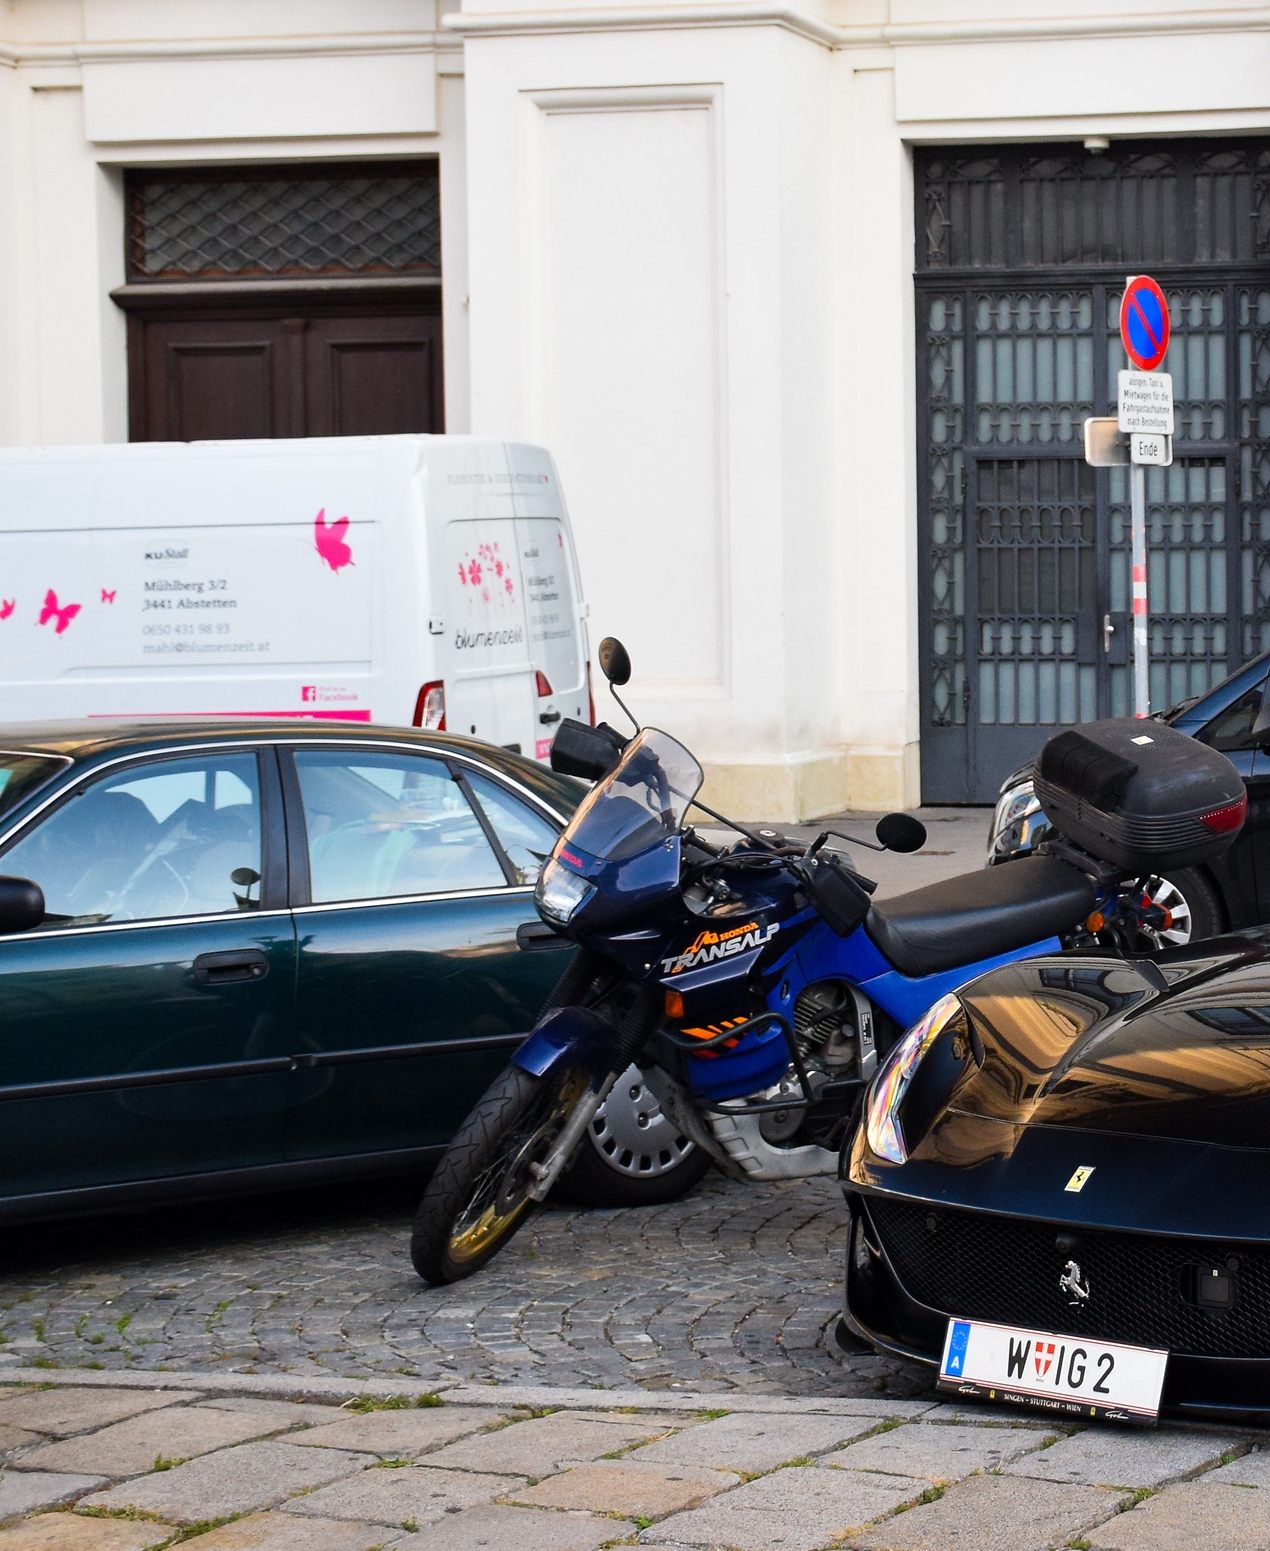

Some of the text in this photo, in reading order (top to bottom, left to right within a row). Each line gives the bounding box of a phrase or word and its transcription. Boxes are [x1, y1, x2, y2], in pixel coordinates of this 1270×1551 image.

[1139, 440, 1158, 456] Ende
[144, 580, 228, 593] Mühlberg 3/2
[144, 598, 238, 610] 3441 Abstetten
[174, 624, 195, 634] 431
[454, 625, 524, 650] blumenzeit
[719, 922, 759, 942] HONDA
[661, 922, 780, 974] TRANSALP
[951, 1358, 960, 1369] A
[1007, 1337, 1032, 1380] W
[1004, 1393, 1025, 1402] SINGEN
[1030, 1398, 1060, 1408] STUTTGART
[1066, 1403, 1082, 1412] WIEN
